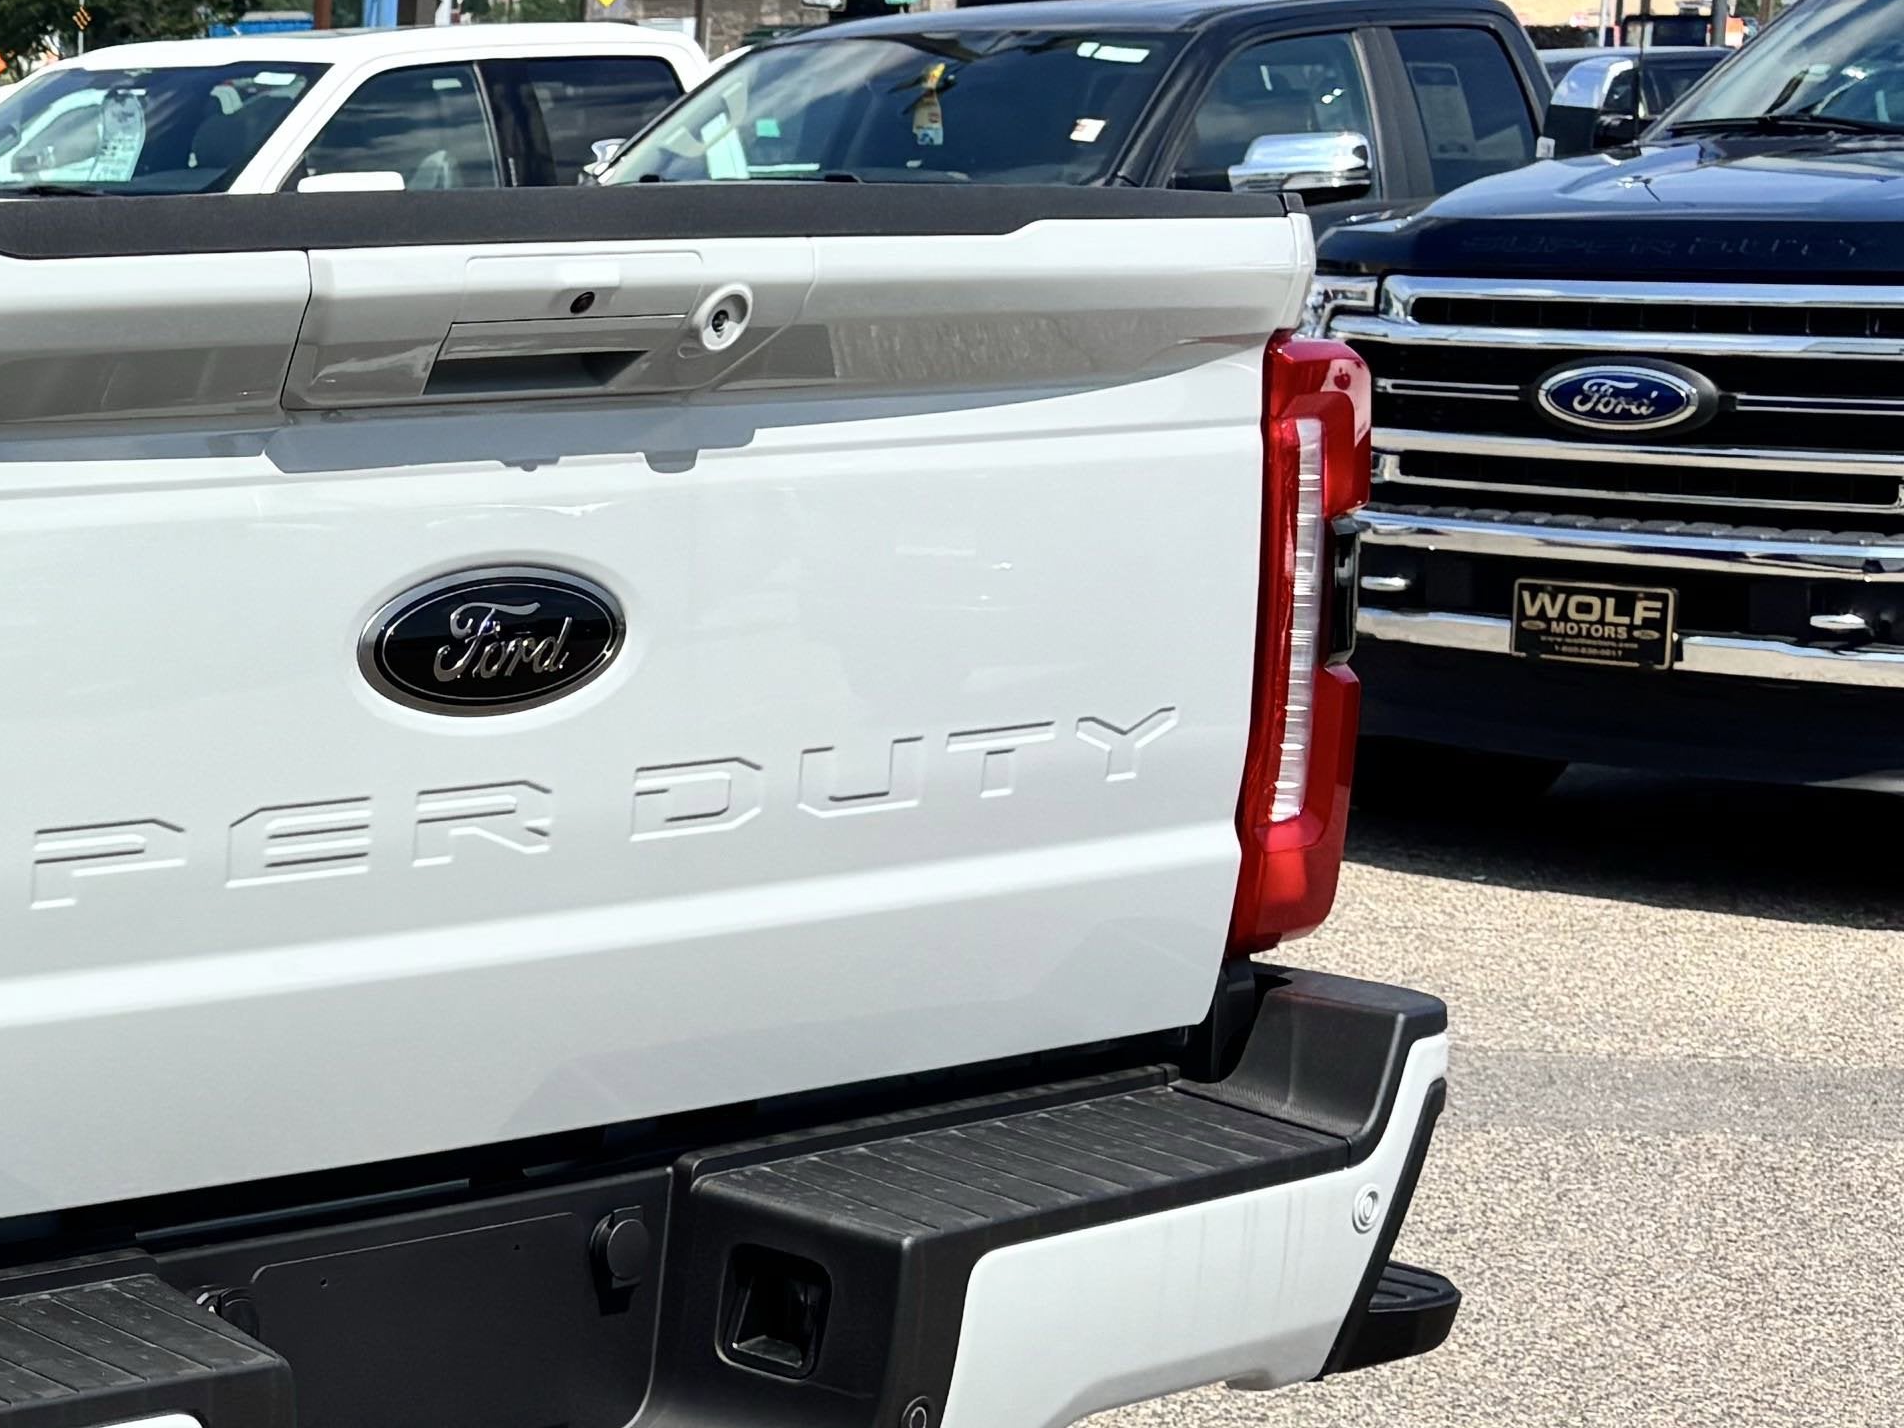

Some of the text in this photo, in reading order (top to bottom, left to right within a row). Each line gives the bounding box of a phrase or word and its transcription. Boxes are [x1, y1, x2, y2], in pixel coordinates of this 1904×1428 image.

[1572, 379, 1657, 417] Ford
[1521, 590, 1663, 625] WOLF
[434, 601, 573, 683] Ford
[1550, 620, 1628, 639] MOTORS
[630, 705, 1180, 845] DUTY
